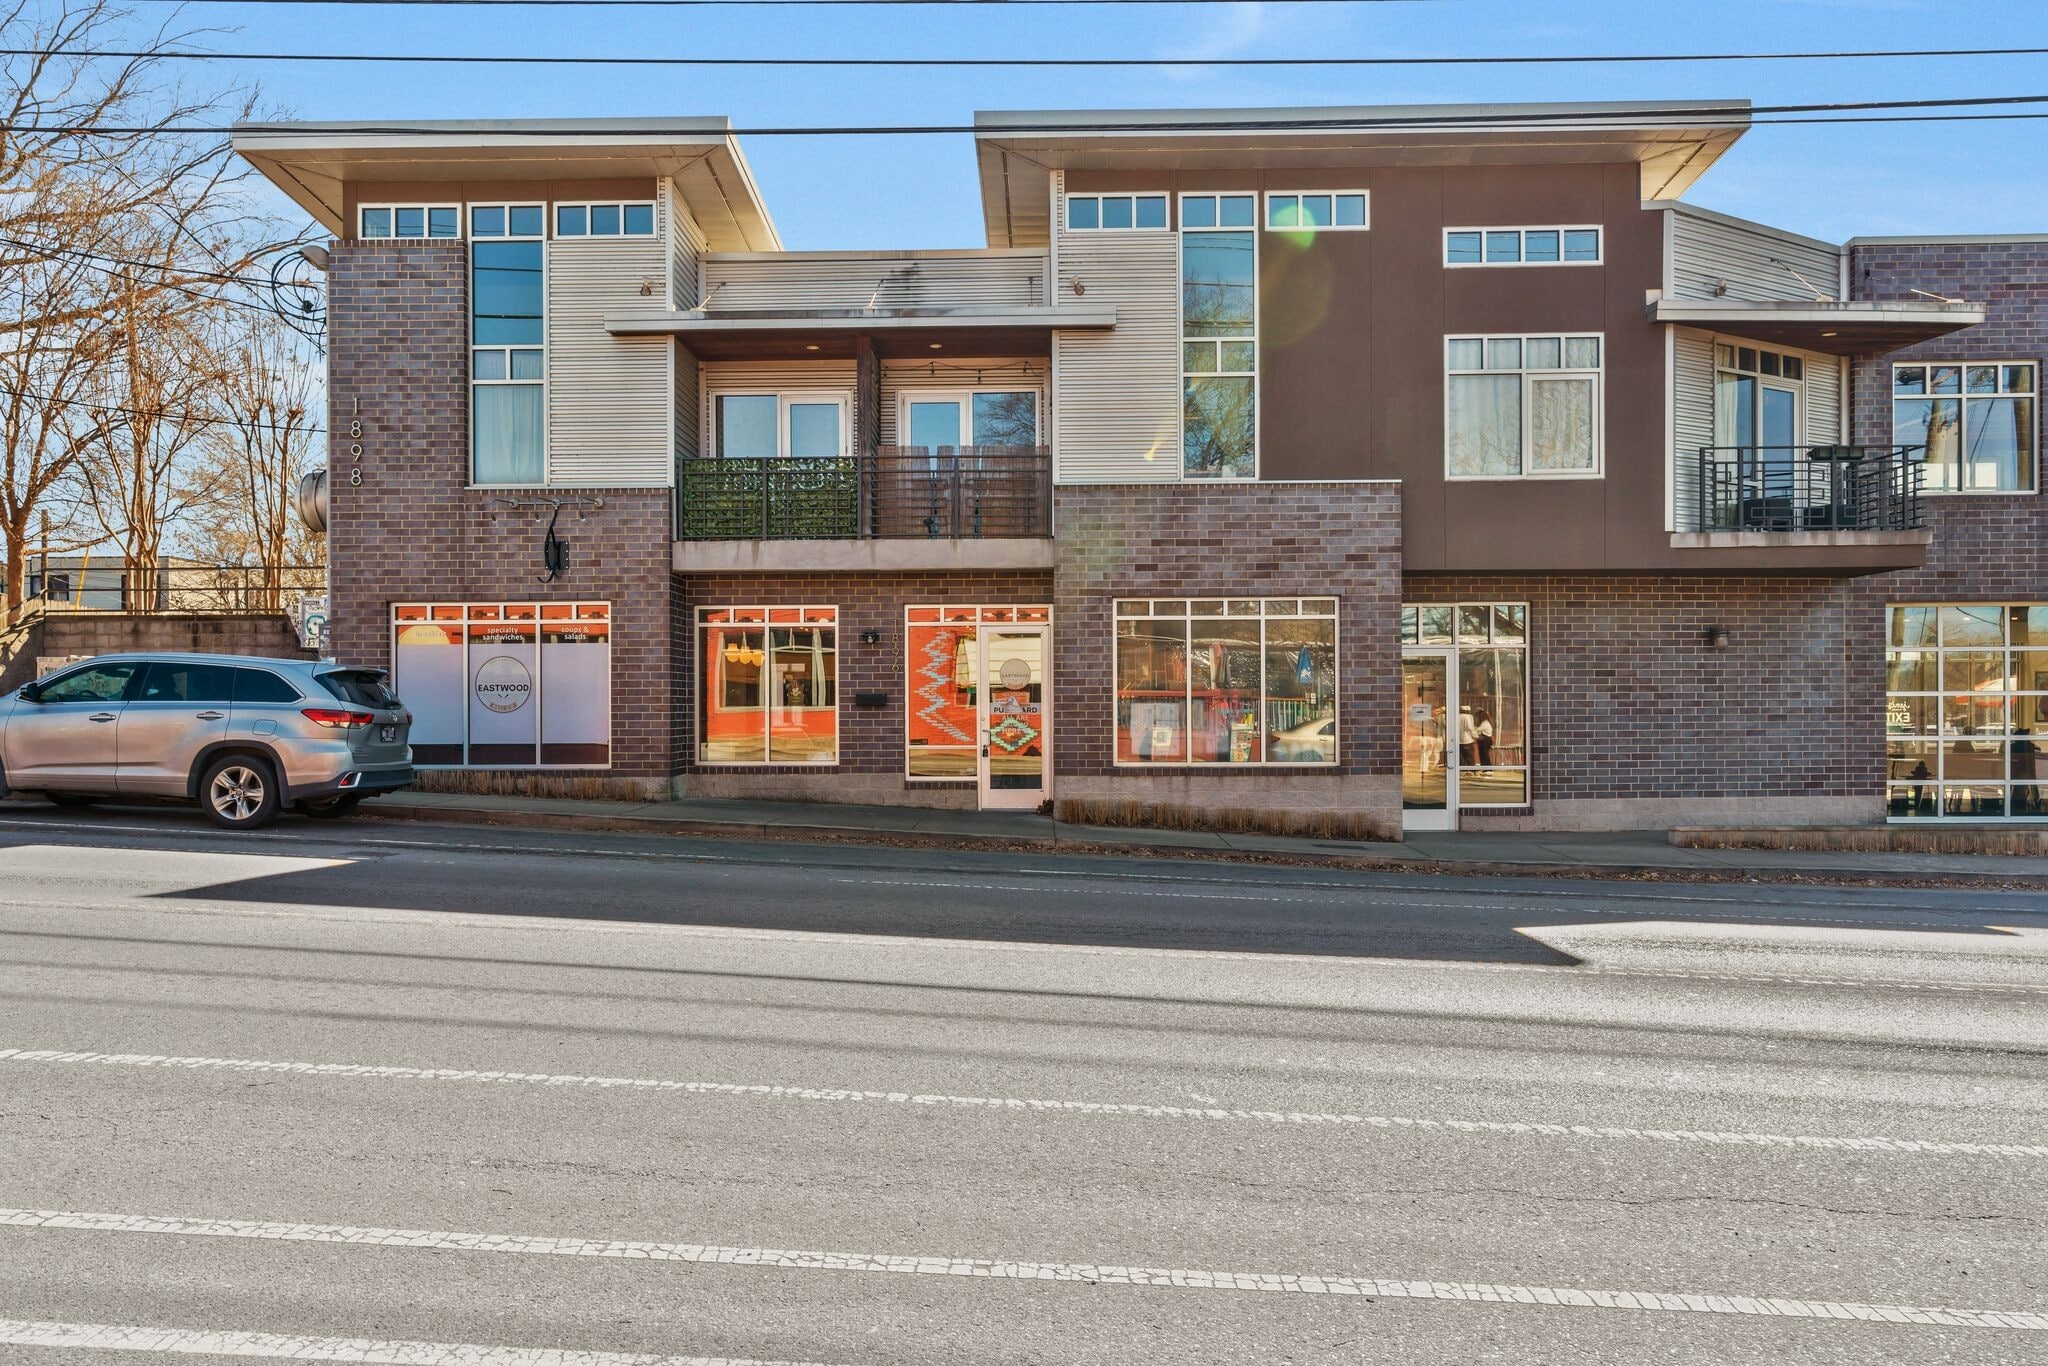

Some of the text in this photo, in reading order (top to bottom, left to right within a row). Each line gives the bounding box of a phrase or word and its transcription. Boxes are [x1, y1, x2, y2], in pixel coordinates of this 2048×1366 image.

[351, 397, 362, 485] 1898
[482, 633, 523, 641] sandwiches
[478, 684, 529, 692] EASTWOOD
